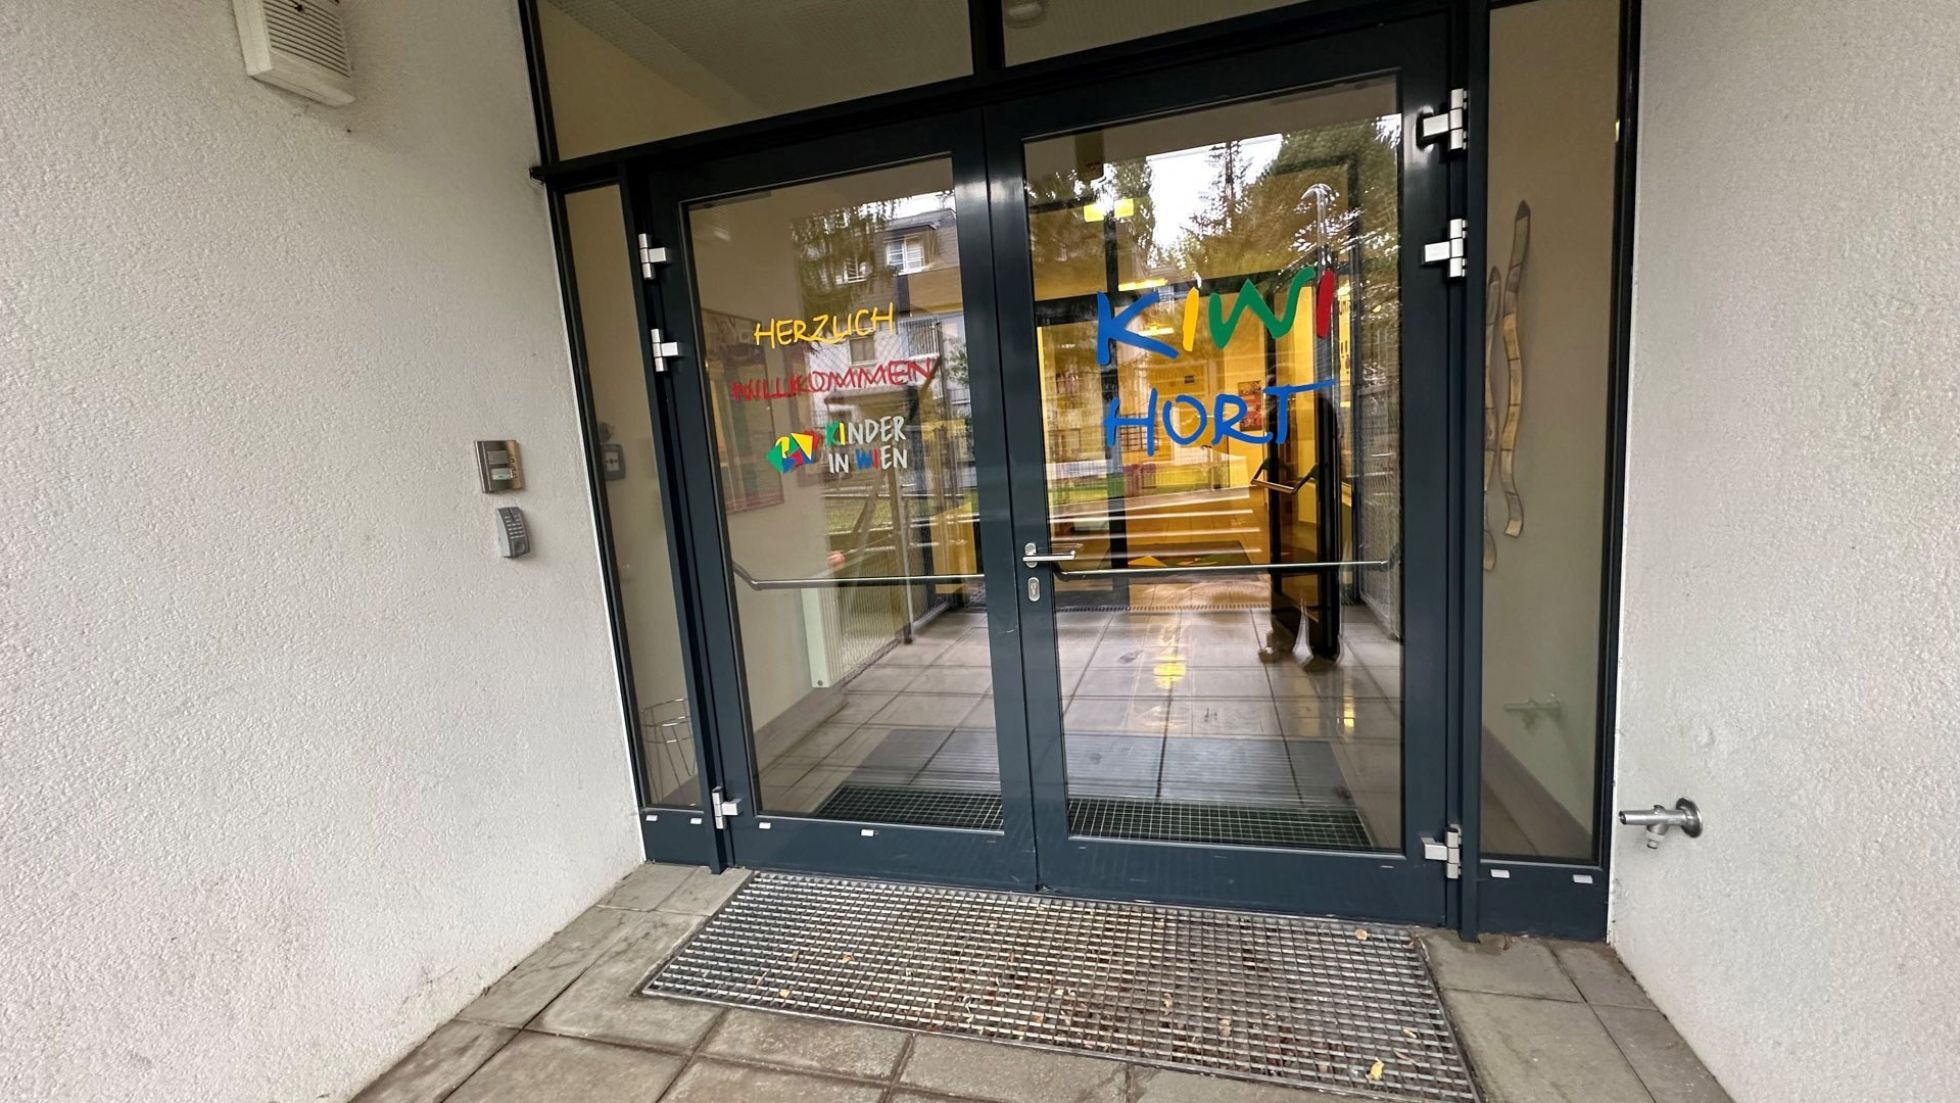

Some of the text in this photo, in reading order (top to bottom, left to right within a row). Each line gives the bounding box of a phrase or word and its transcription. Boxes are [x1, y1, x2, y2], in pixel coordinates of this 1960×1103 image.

[754, 302, 894, 349] HERZLICH
[1096, 267, 1336, 365] KIWI
[731, 356, 934, 402] WILLKOMMEN
[825, 415, 907, 447] KINDER
[1104, 379, 1336, 457] HORT
[828, 446, 908, 474] IN WIEN
